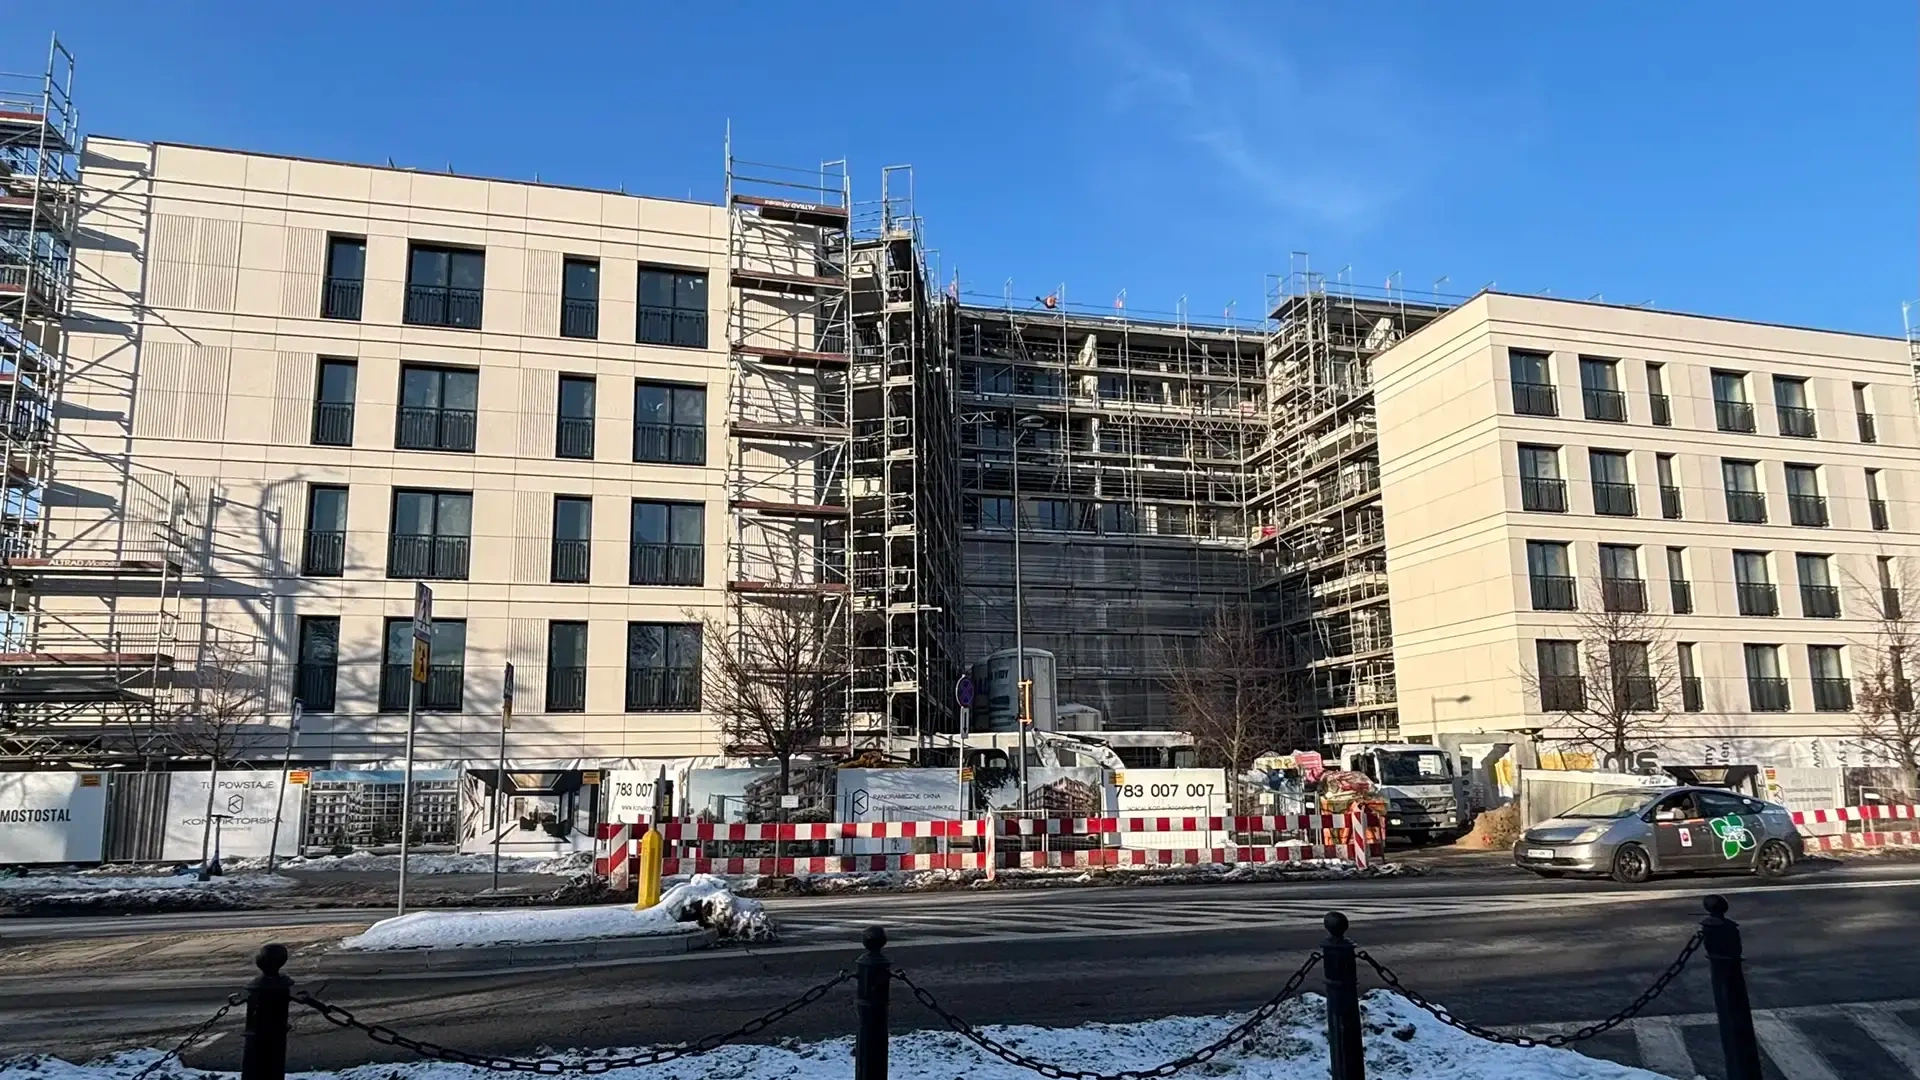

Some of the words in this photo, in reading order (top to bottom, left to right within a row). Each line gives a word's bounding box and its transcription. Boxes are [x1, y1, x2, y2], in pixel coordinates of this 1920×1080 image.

[218, 781, 274, 789] POWSTAJE
[616, 783, 632, 796] 783
[636, 783, 653, 797] 007
[1114, 784, 1144, 797] 783
[1151, 783, 1179, 797] 007
[1186, 783, 1214, 797] 007
[0, 809, 71, 822] MOSTOSTAL
[1724, 833, 1747, 841] TAXI
